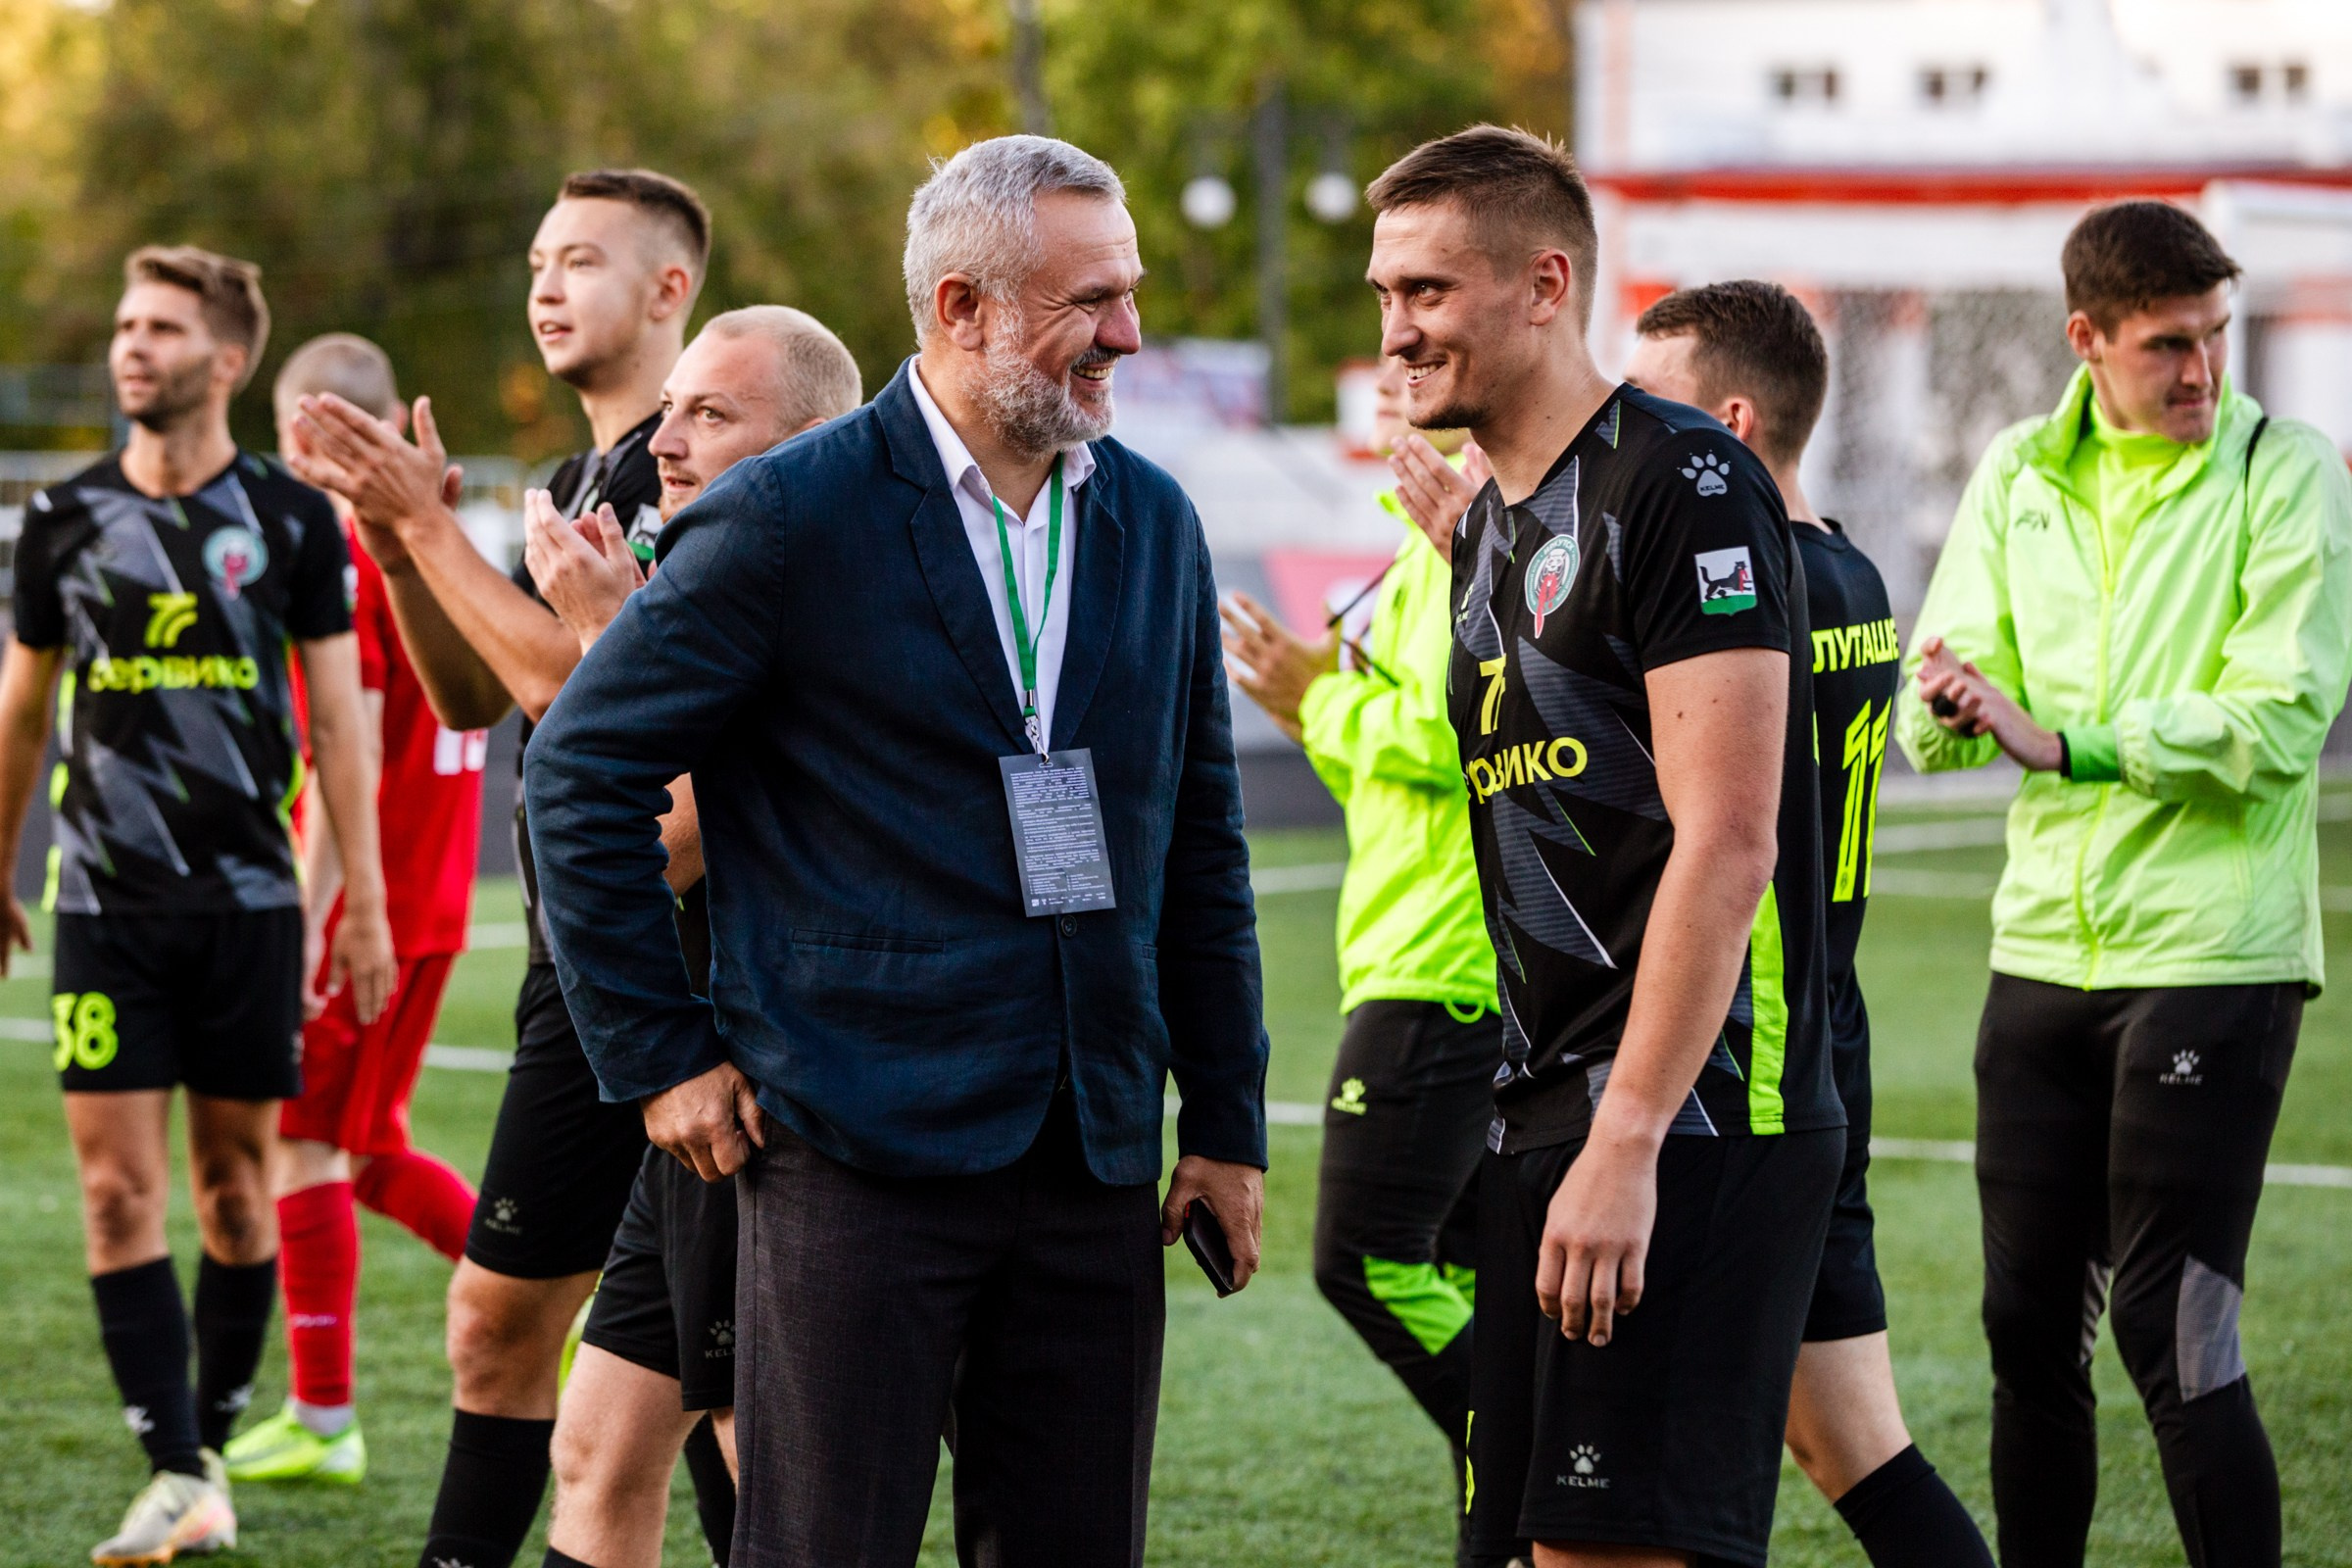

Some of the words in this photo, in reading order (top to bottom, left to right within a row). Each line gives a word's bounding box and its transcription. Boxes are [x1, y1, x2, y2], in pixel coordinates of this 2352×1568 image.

[1832, 697, 1891, 903] 11
[2160, 1072, 2202, 1085] KELME
[1556, 1474, 1610, 1489] KELME
